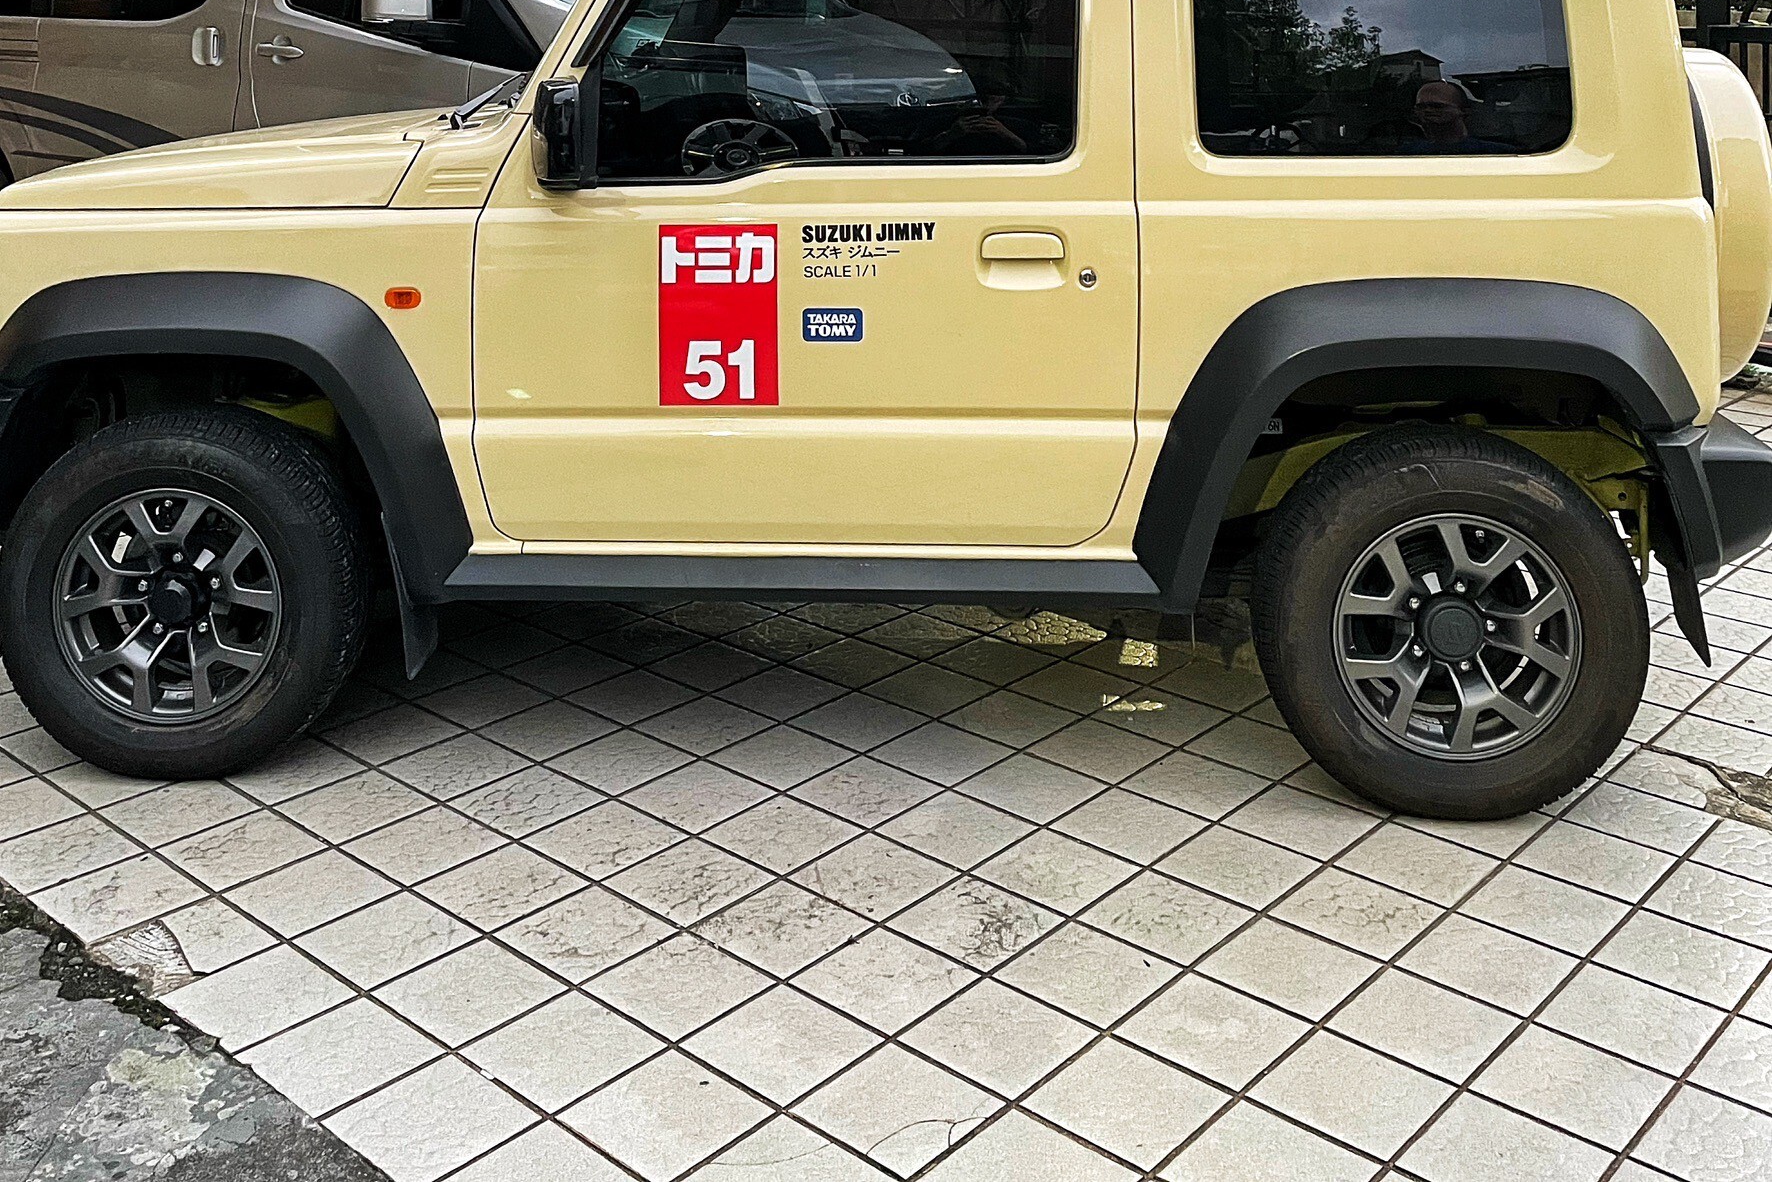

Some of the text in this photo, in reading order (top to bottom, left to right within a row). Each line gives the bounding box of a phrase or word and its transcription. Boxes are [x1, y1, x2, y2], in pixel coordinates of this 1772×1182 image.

[801, 222, 936, 243] SUZUKI JIMNY
[661, 232, 775, 284] トミカ
[802, 245, 900, 259] スズキ ジムニー
[803, 264, 876, 278] SCALE 1/1
[807, 313, 856, 324] TAKARA
[807, 325, 856, 337] TOMY
[683, 339, 755, 400] 51
